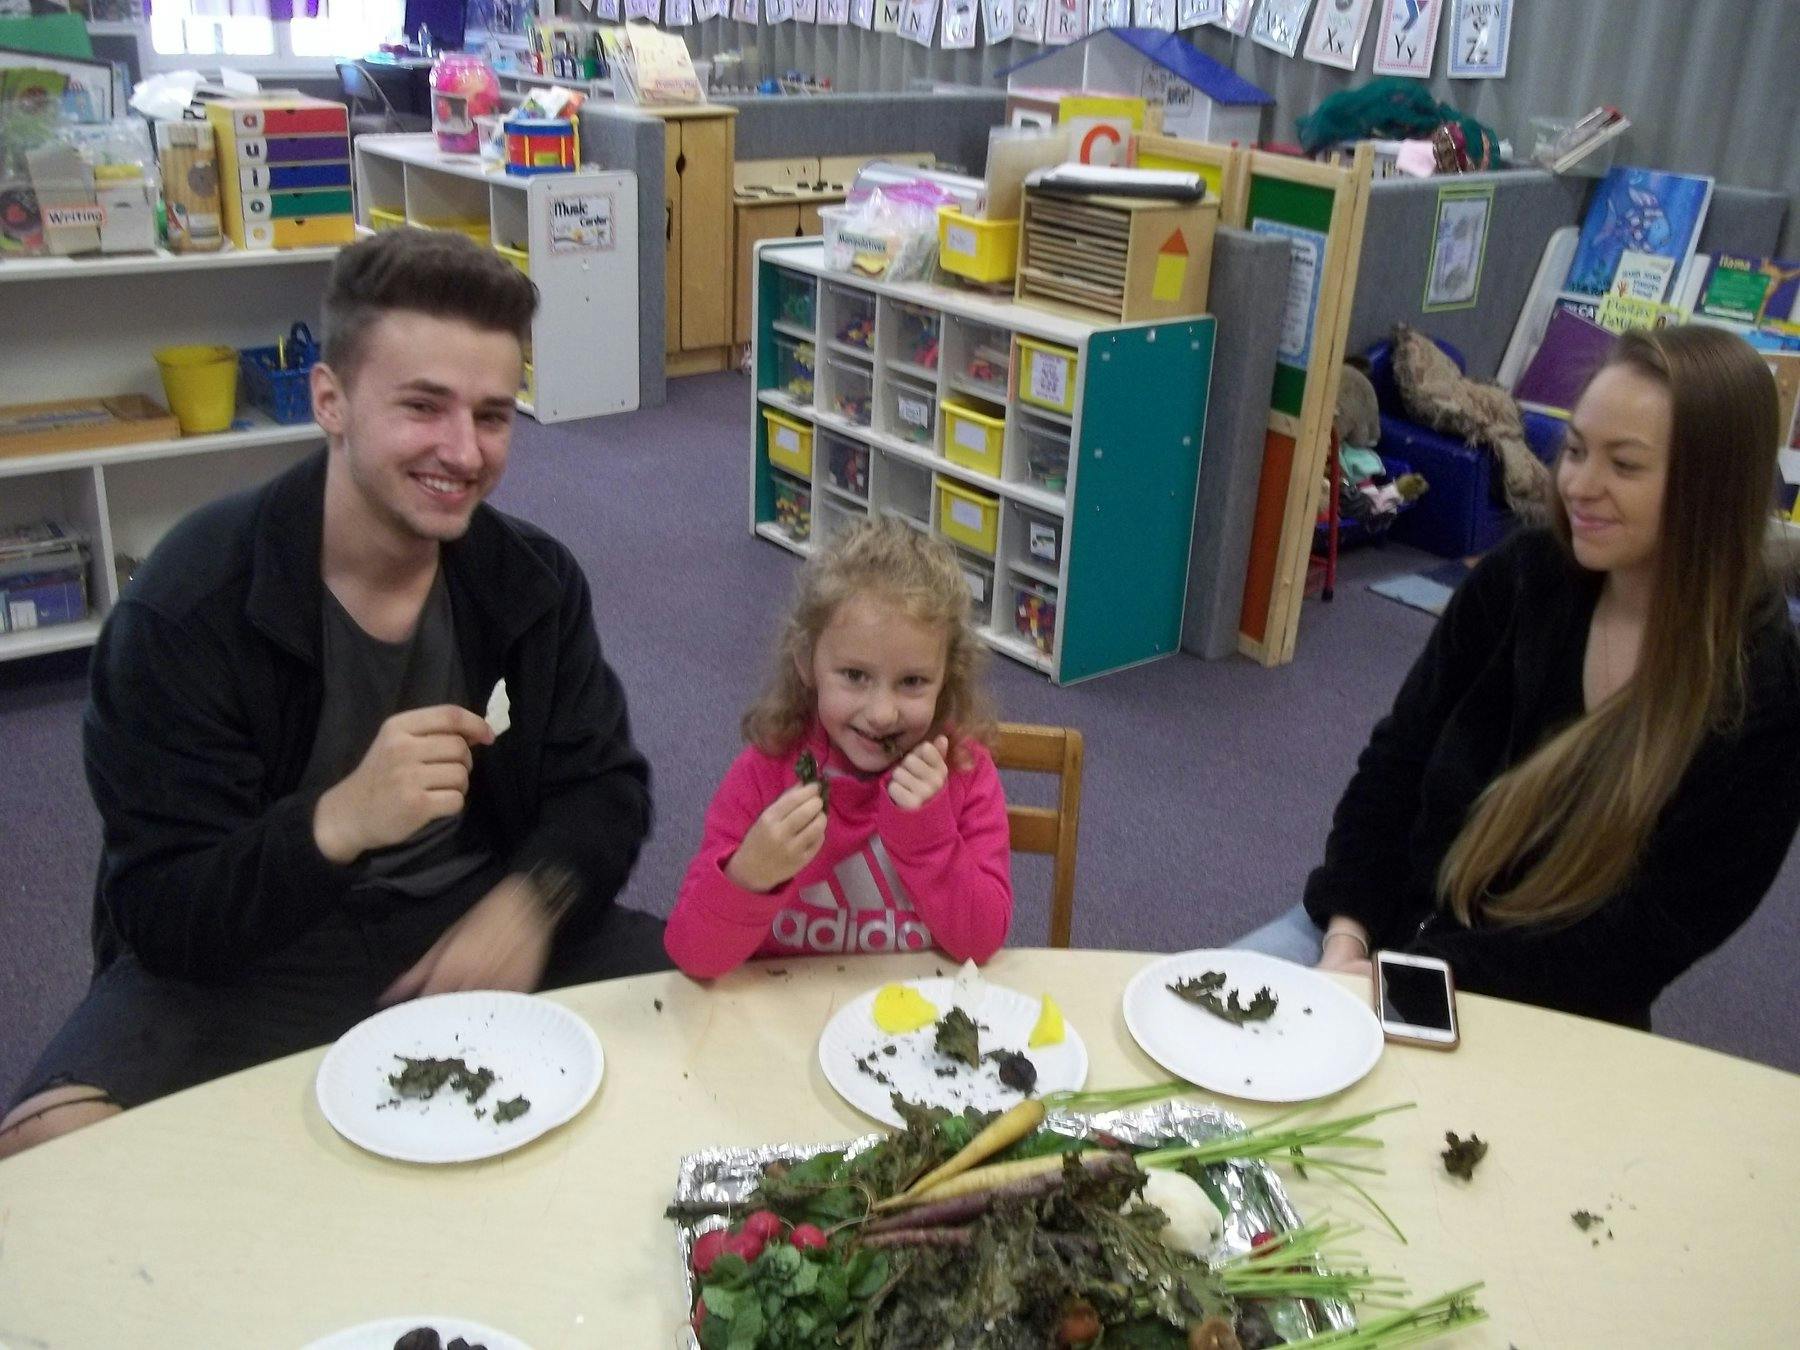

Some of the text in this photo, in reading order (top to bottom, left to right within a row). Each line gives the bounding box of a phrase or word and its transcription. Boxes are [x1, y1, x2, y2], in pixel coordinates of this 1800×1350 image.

[49, 207, 104, 226] Writing
[554, 198, 589, 217] Music
[771, 906, 934, 952] adida
